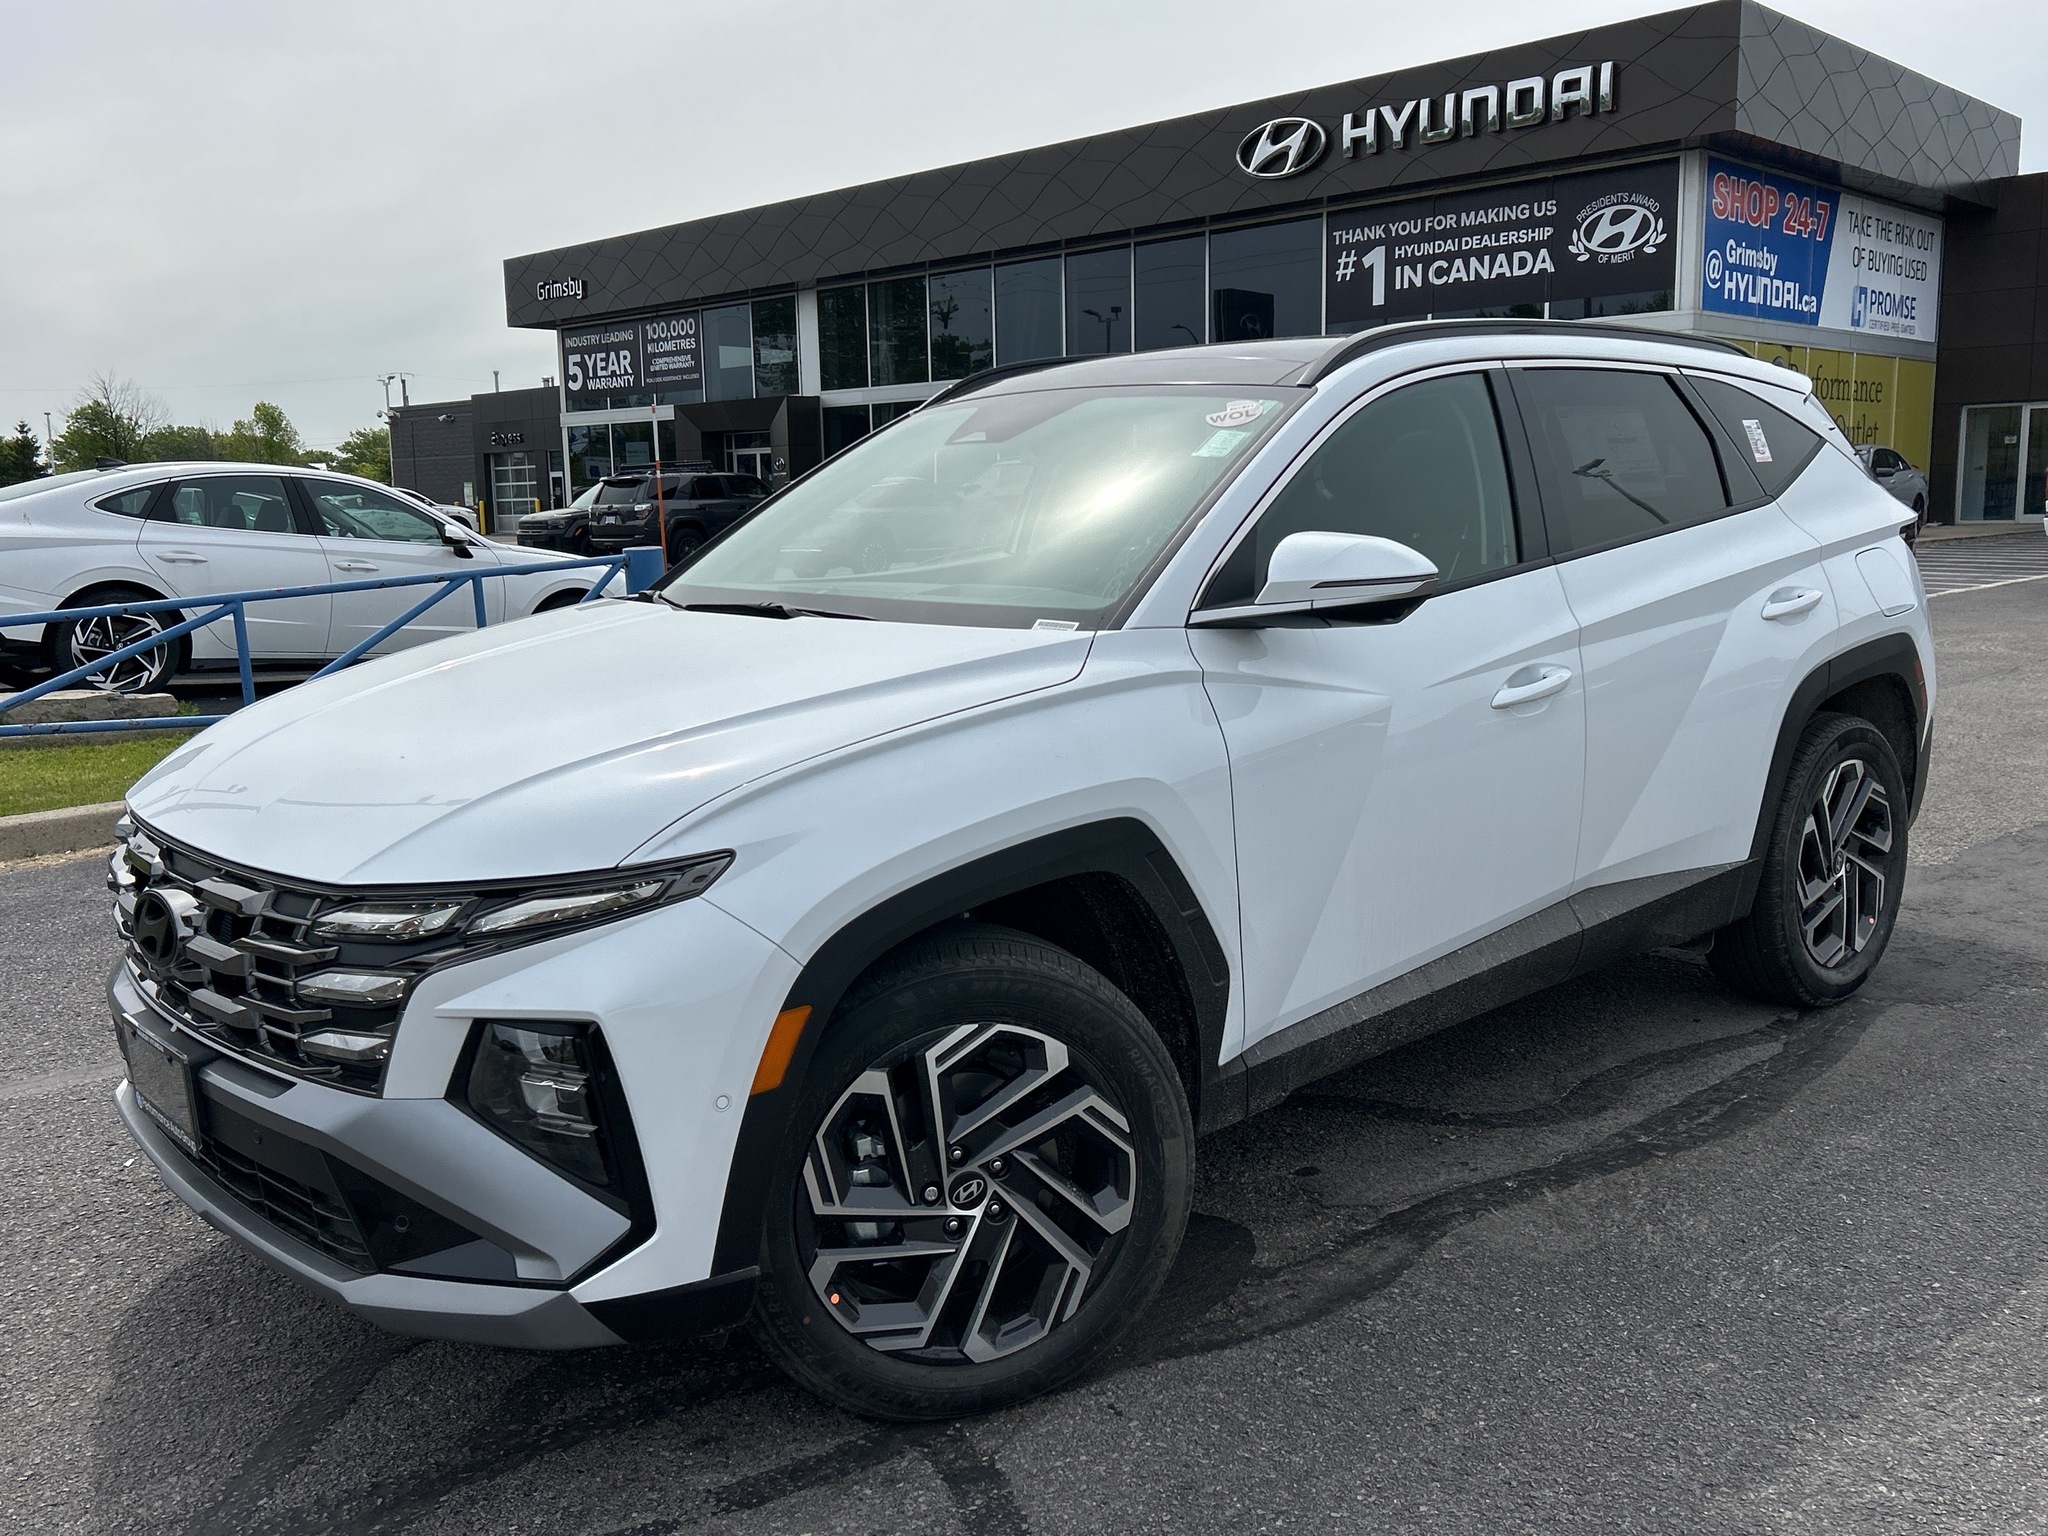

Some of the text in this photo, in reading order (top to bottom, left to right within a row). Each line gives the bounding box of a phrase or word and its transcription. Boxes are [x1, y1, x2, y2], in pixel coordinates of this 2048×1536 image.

[1342, 61, 1617, 159] HYUNDAI
[1629, 192, 1660, 213] AWARD
[1712, 172, 1831, 241] SHOP 24-7
[1332, 200, 1558, 245] THANK YOU FOR MAKING US
[1848, 210, 1935, 252] TAKE THE RISK OUT
[1395, 227, 1554, 259] HYUNDAI DEALERSHIP
[1598, 249, 1635, 264] OF MERIT
[1726, 238, 1778, 277] Grimsby
[1395, 248, 1555, 290] IN CANADA
[1853, 246, 1927, 281] OF BUYING USED
[537, 276, 583, 300] Grimsby
[1724, 270, 1817, 313] HYUNDAI.ca
[1870, 289, 1917, 320] PROMISE
[565, 329, 634, 348] INDUSTRY LEADING
[645, 317, 695, 340] 100,000
[647, 337, 696, 354] KILOMETRES
[568, 349, 633, 391] 5 YEAR
[668, 360, 695, 370] WARRANTY
[587, 375, 635, 391] WARRANTY
[1811, 364, 1883, 403] formance
